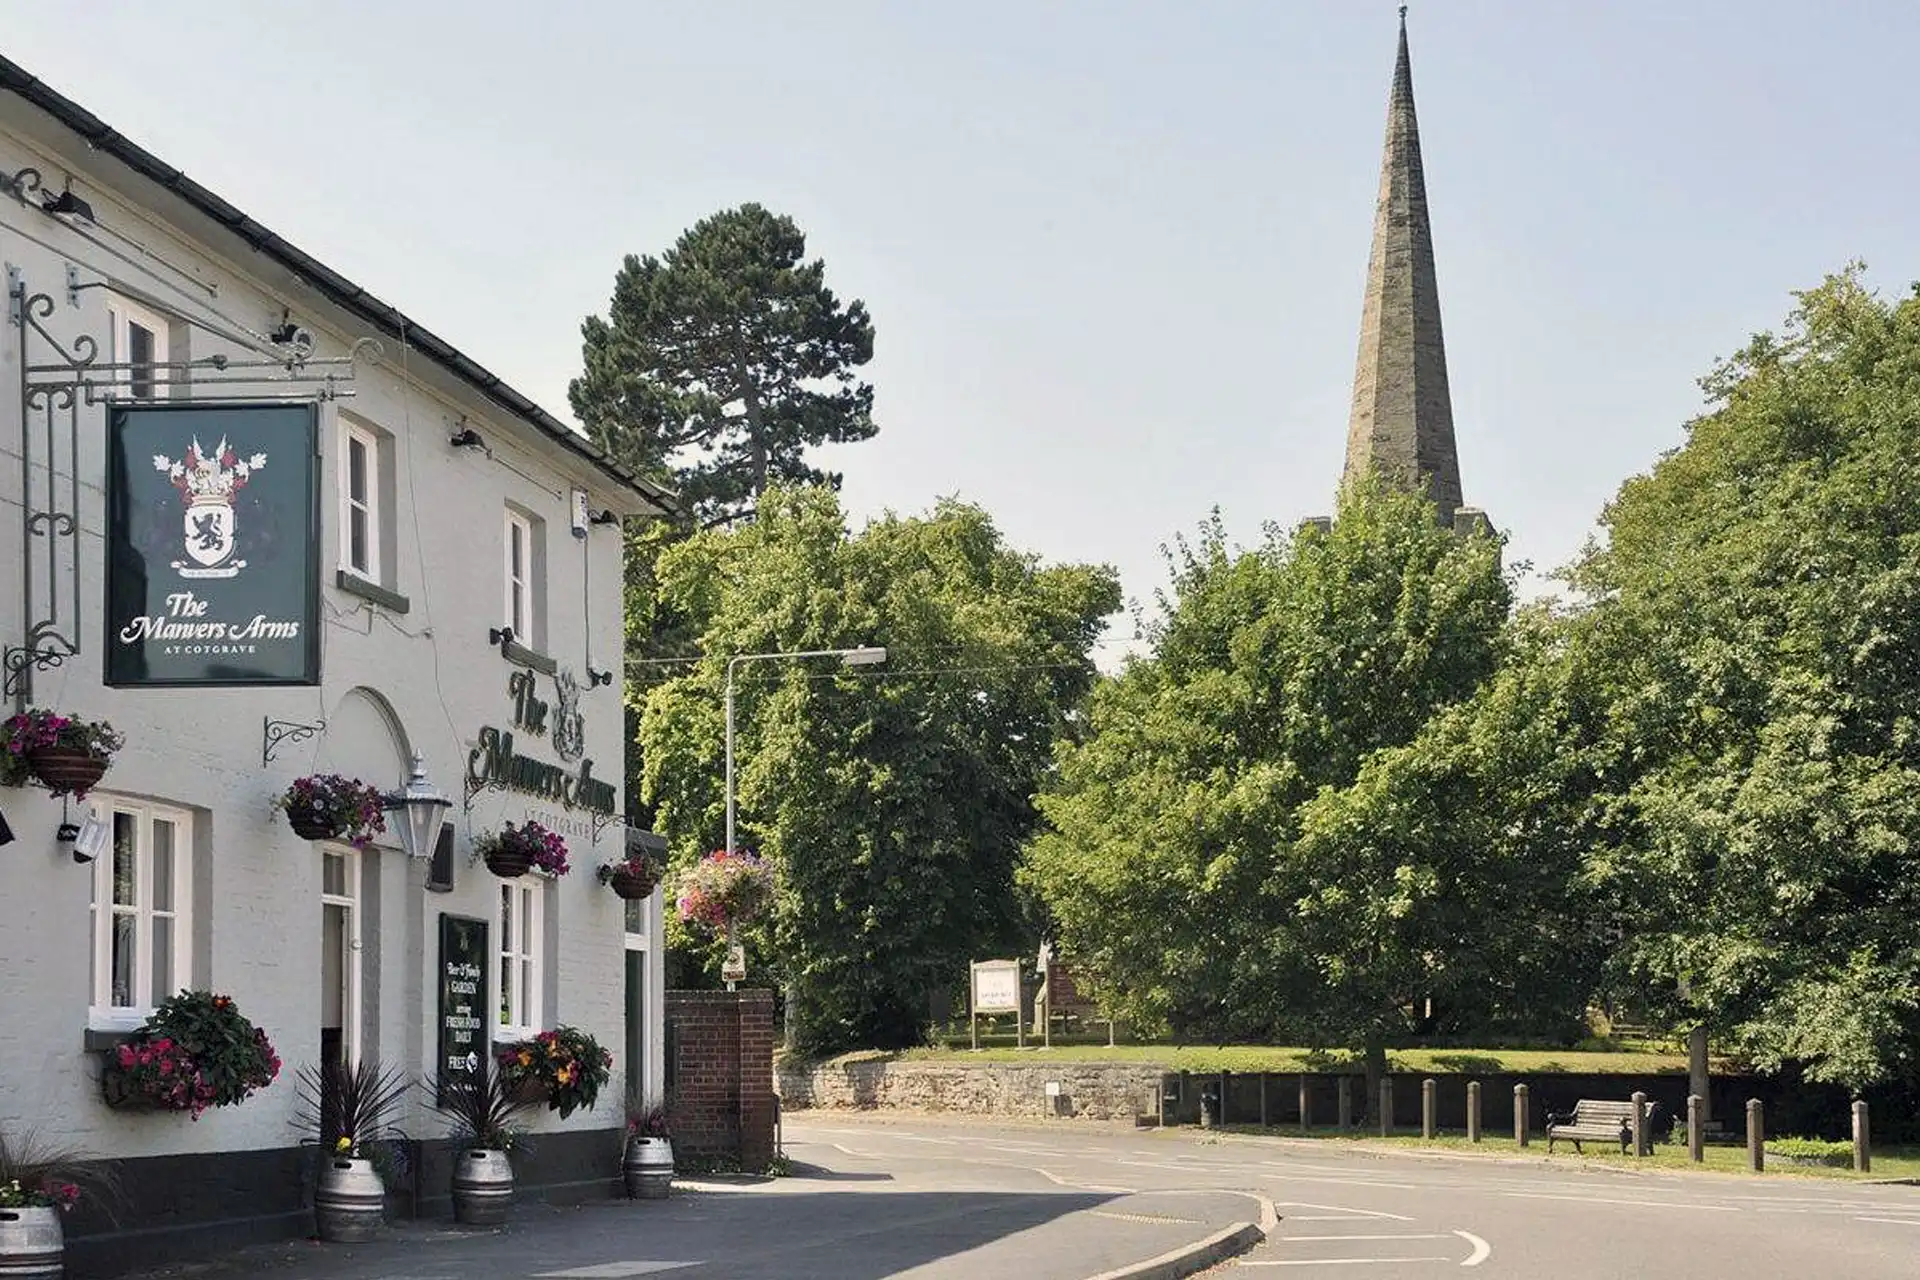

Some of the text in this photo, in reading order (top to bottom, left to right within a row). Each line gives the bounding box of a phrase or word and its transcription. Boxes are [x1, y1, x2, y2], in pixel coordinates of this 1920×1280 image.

[166, 591, 208, 617] The
[120, 614, 299, 643] Manvers Arms
[164, 645, 256, 655] AT COTGRAVE
[509, 669, 548, 737] The
